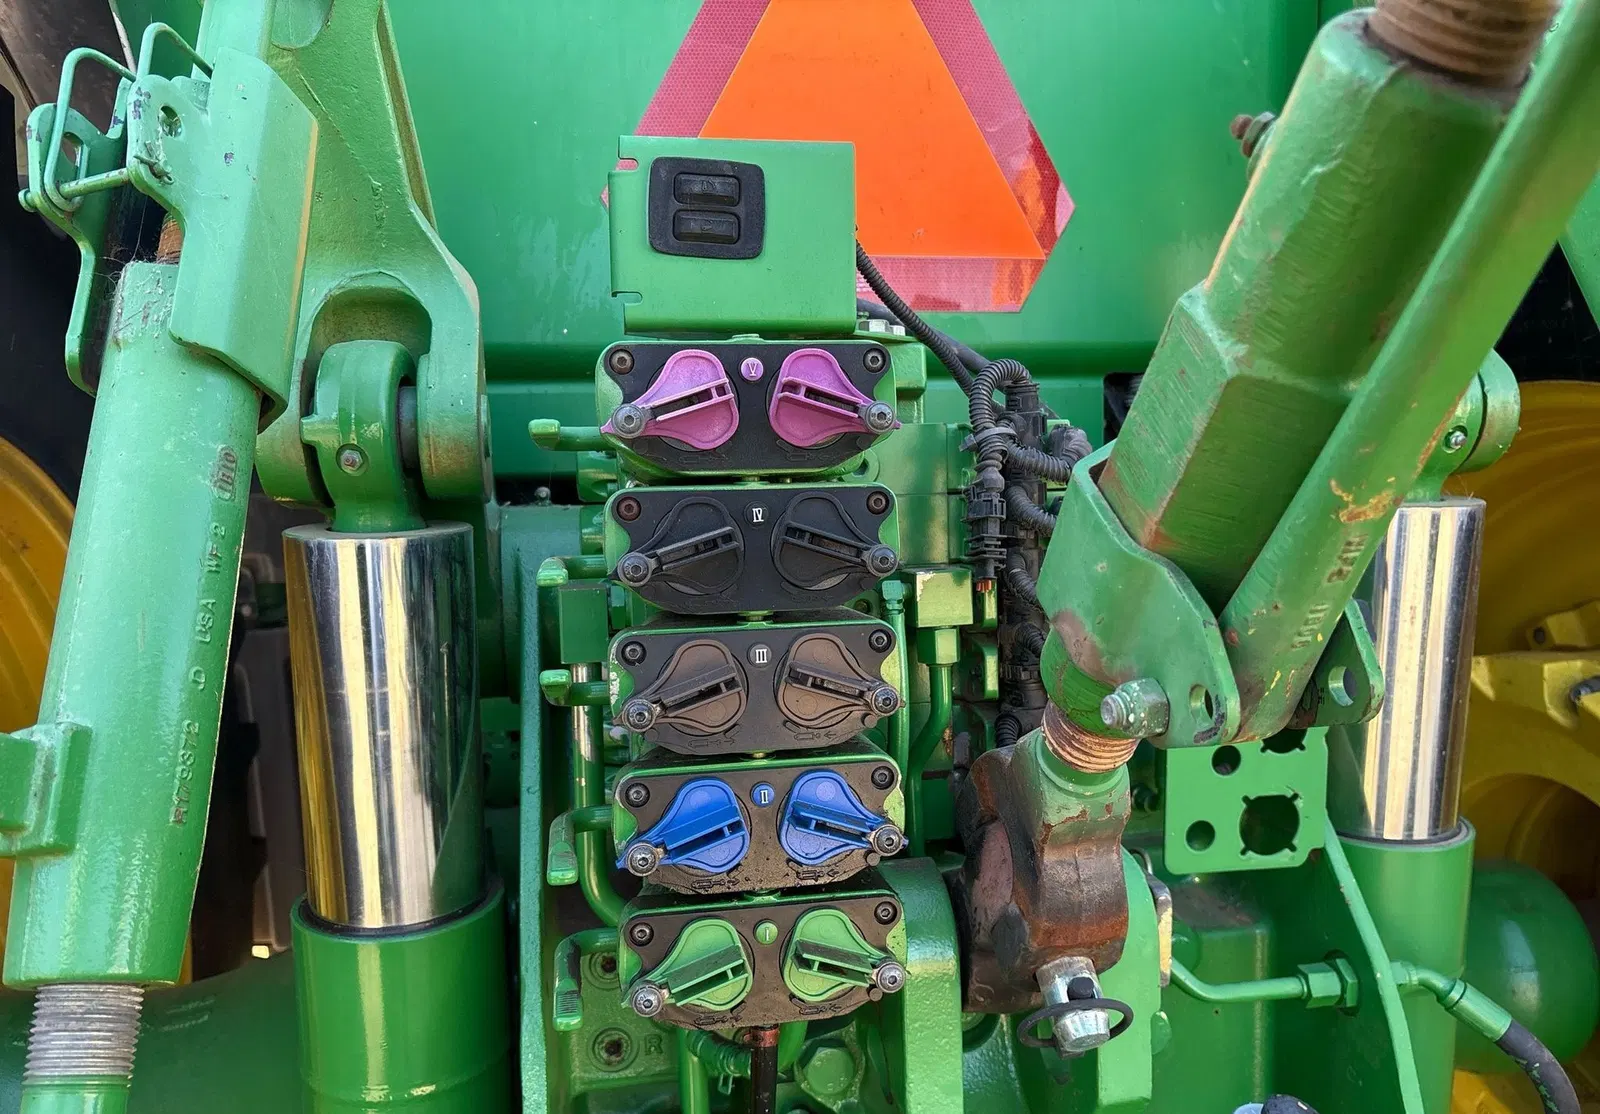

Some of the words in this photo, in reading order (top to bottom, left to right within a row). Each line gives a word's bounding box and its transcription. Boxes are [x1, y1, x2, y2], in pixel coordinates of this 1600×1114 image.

[746, 361, 759, 377] V
[751, 507, 765, 523] IV
[196, 599, 216, 643] USA
[755, 648, 768, 664] III
[760, 789, 769, 804] II
[643, 1033, 664, 1057] R
